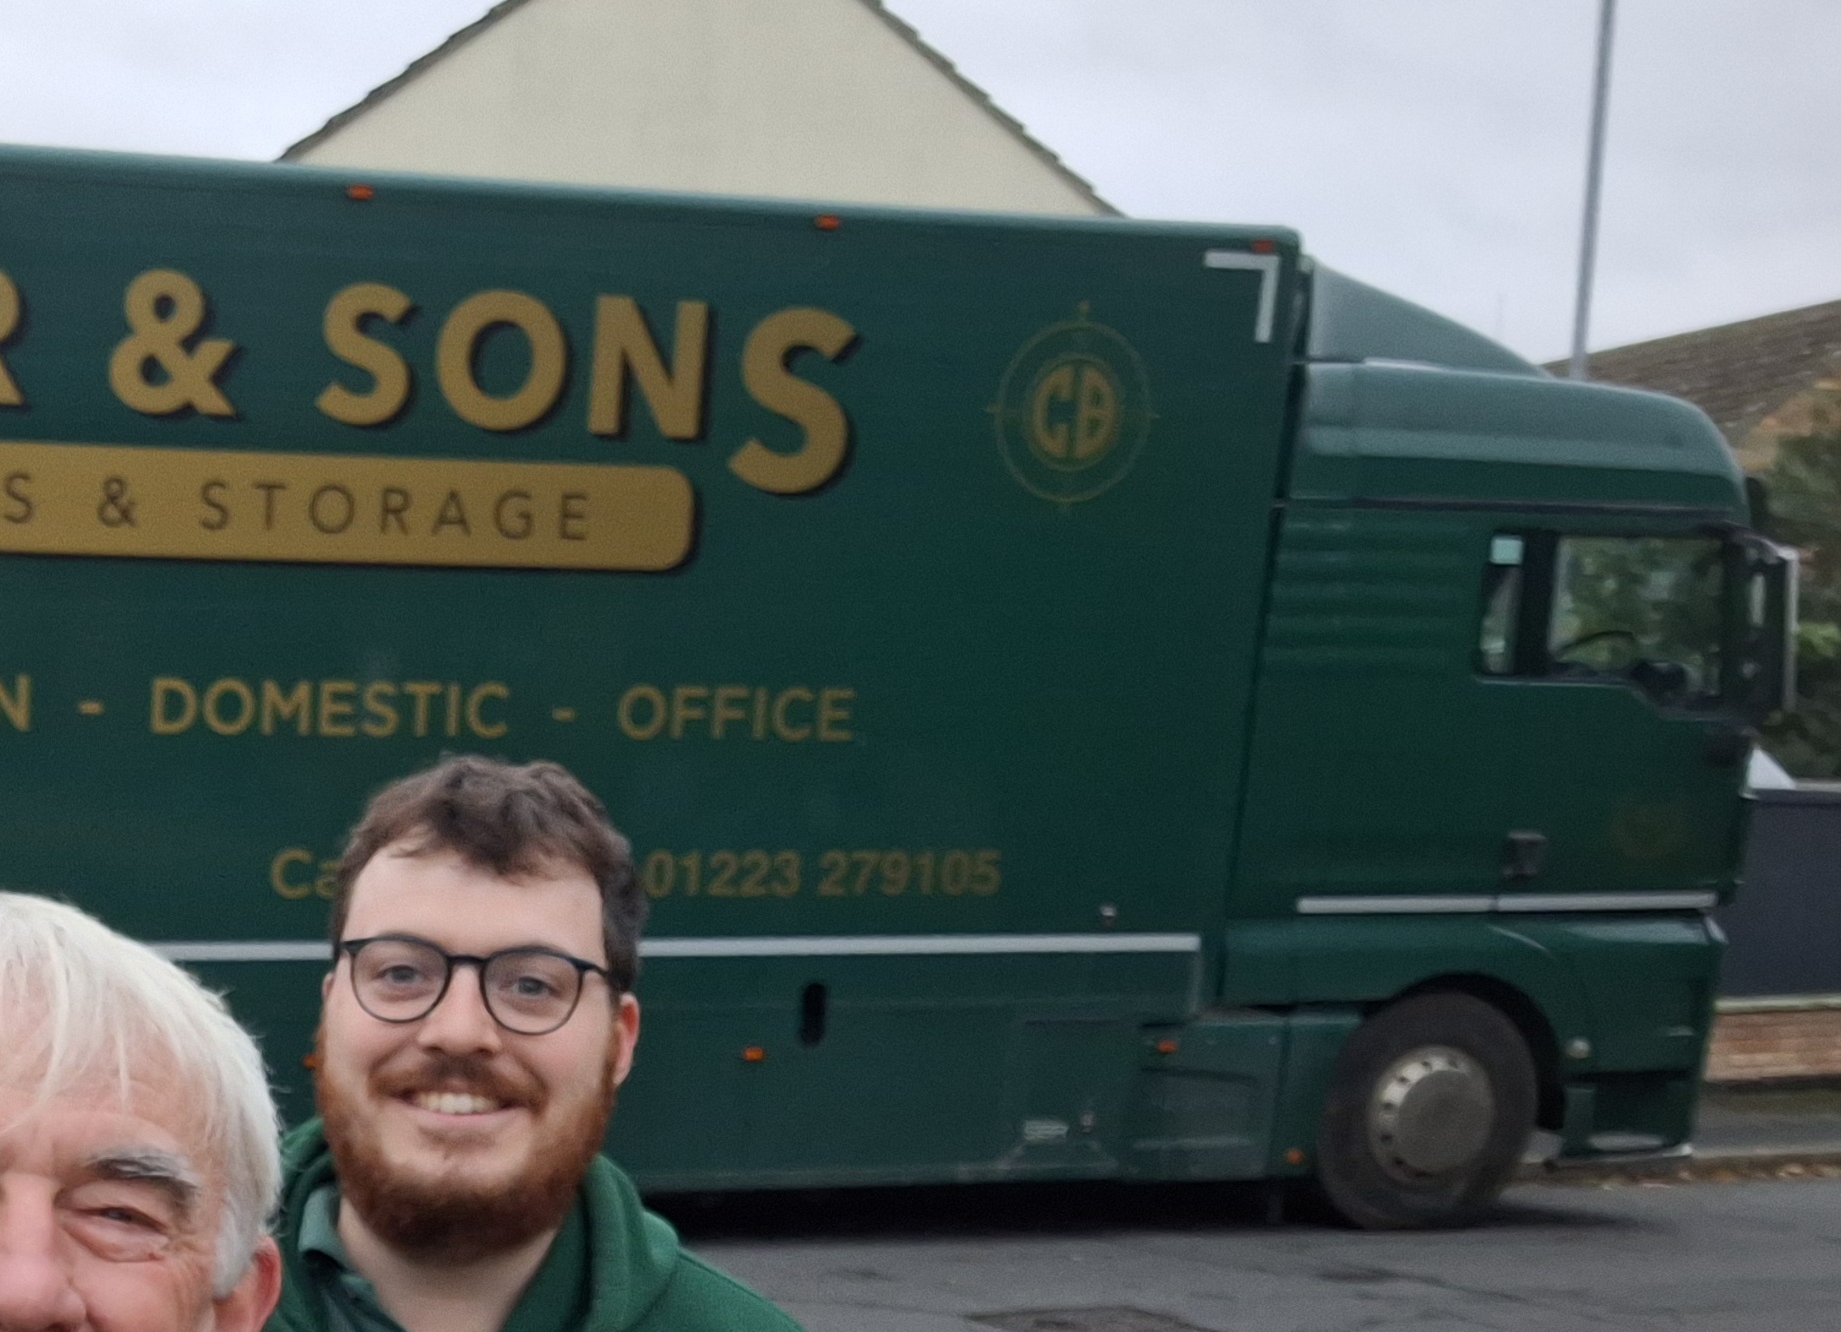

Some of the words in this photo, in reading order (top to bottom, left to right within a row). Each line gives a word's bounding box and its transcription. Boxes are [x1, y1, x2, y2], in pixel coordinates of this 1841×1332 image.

[108, 268, 238, 418] &
[317, 282, 859, 494] SONS
[97, 476, 139, 528] &
[199, 480, 589, 541] STORAGE
[150, 677, 511, 739] DOMESTIC
[617, 685, 856, 742] OFFICE
[643, 848, 801, 898] 01223
[818, 848, 1003, 898] 279105
